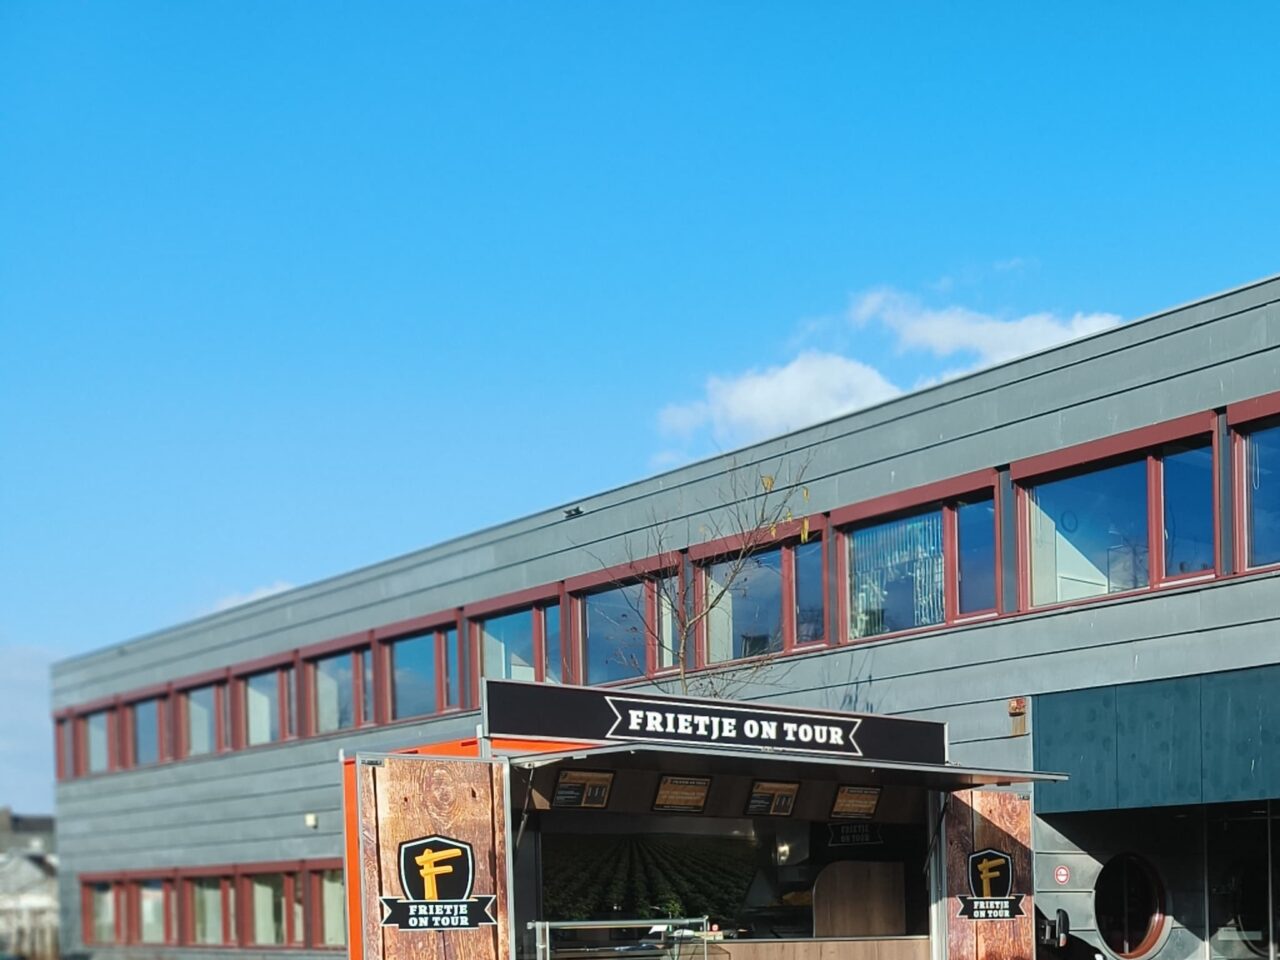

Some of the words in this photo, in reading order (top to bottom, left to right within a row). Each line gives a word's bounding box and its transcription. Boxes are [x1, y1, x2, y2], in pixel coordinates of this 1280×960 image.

[628, 709, 737, 740] FRIETJE
[743, 720, 778, 740] ON
[783, 722, 844, 745] TOUR
[409, 904, 468, 916] FRIETJE
[973, 900, 1010, 909] FRIETJE
[973, 910, 986, 918] ON
[987, 909, 1010, 918] TOUR
[408, 916, 429, 927] ON
[432, 916, 469, 927] TOUR
